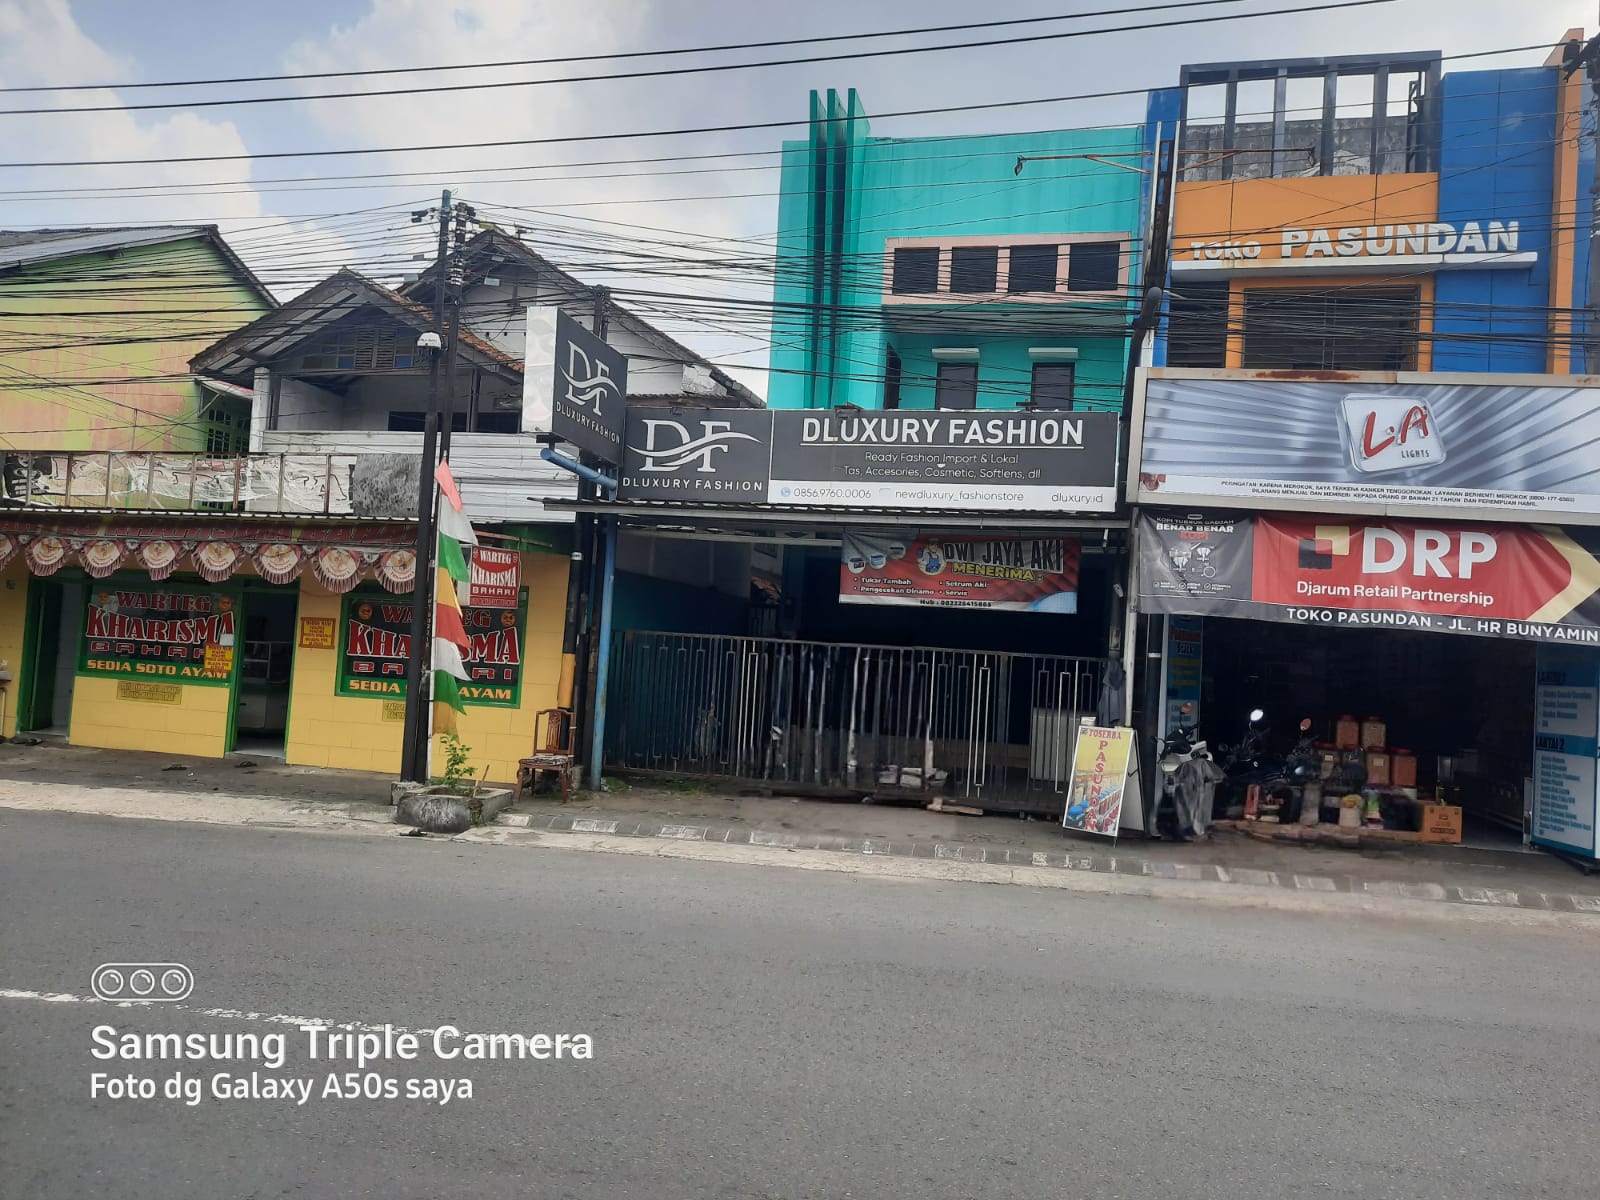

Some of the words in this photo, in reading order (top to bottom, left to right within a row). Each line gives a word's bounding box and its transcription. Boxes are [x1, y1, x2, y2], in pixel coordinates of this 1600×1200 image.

[1191, 241, 1261, 260] TOKO
[1281, 220, 1519, 258] PASUNDAN
[556, 401, 590, 427] DLUXURY
[591, 420, 620, 443] FASHION
[802, 417, 940, 443] DLUXURY
[948, 419, 1083, 445] FASHION
[865, 452, 898, 463] Ready
[900, 453, 940, 463] Fashion
[942, 453, 977, 465] Import
[980, 453, 988, 463] &
[991, 453, 1019, 464] Lokal
[1401, 450, 1430, 458] LIGHTS
[843, 465, 863, 477] Tas,
[925, 467, 977, 479] Cosmetic,
[980, 468, 1025, 480] Softlens,
[1028, 469, 1041, 479] dll
[622, 476, 690, 489] DLUXURY
[695, 480, 763, 491] FASHION
[1156, 523, 1193, 531] BENAR
[1196, 525, 1234, 533] BENAR
[480, 549, 511, 564] WARTEG
[943, 542, 976, 562] DWI
[982, 540, 1025, 567] JAYA
[1361, 527, 1498, 580] DRP
[471, 562, 517, 588] KHARISMA
[953, 562, 1034, 581] MENERIMA
[472, 586, 515, 596] BAHARI
[1297, 580, 1350, 599] Djarum
[1353, 583, 1398, 599] Retail
[1400, 585, 1495, 608] Partnership
[116, 591, 212, 613] WARTEG
[85, 603, 235, 645] KHARISMA
[1287, 608, 1333, 622] TOKO
[1337, 612, 1432, 628] PASUNDAN
[1448, 620, 1472, 632] JL.
[1478, 620, 1501, 633] HR
[1507, 622, 1599, 642] BUNYAMIN
[87, 659, 132, 672] SEDIA
[136, 661, 176, 675] SOTO
[349, 679, 401, 694] SEDIA
[458, 686, 512, 700] AYAM
[1085, 740, 1108, 831] PASUNDAN
